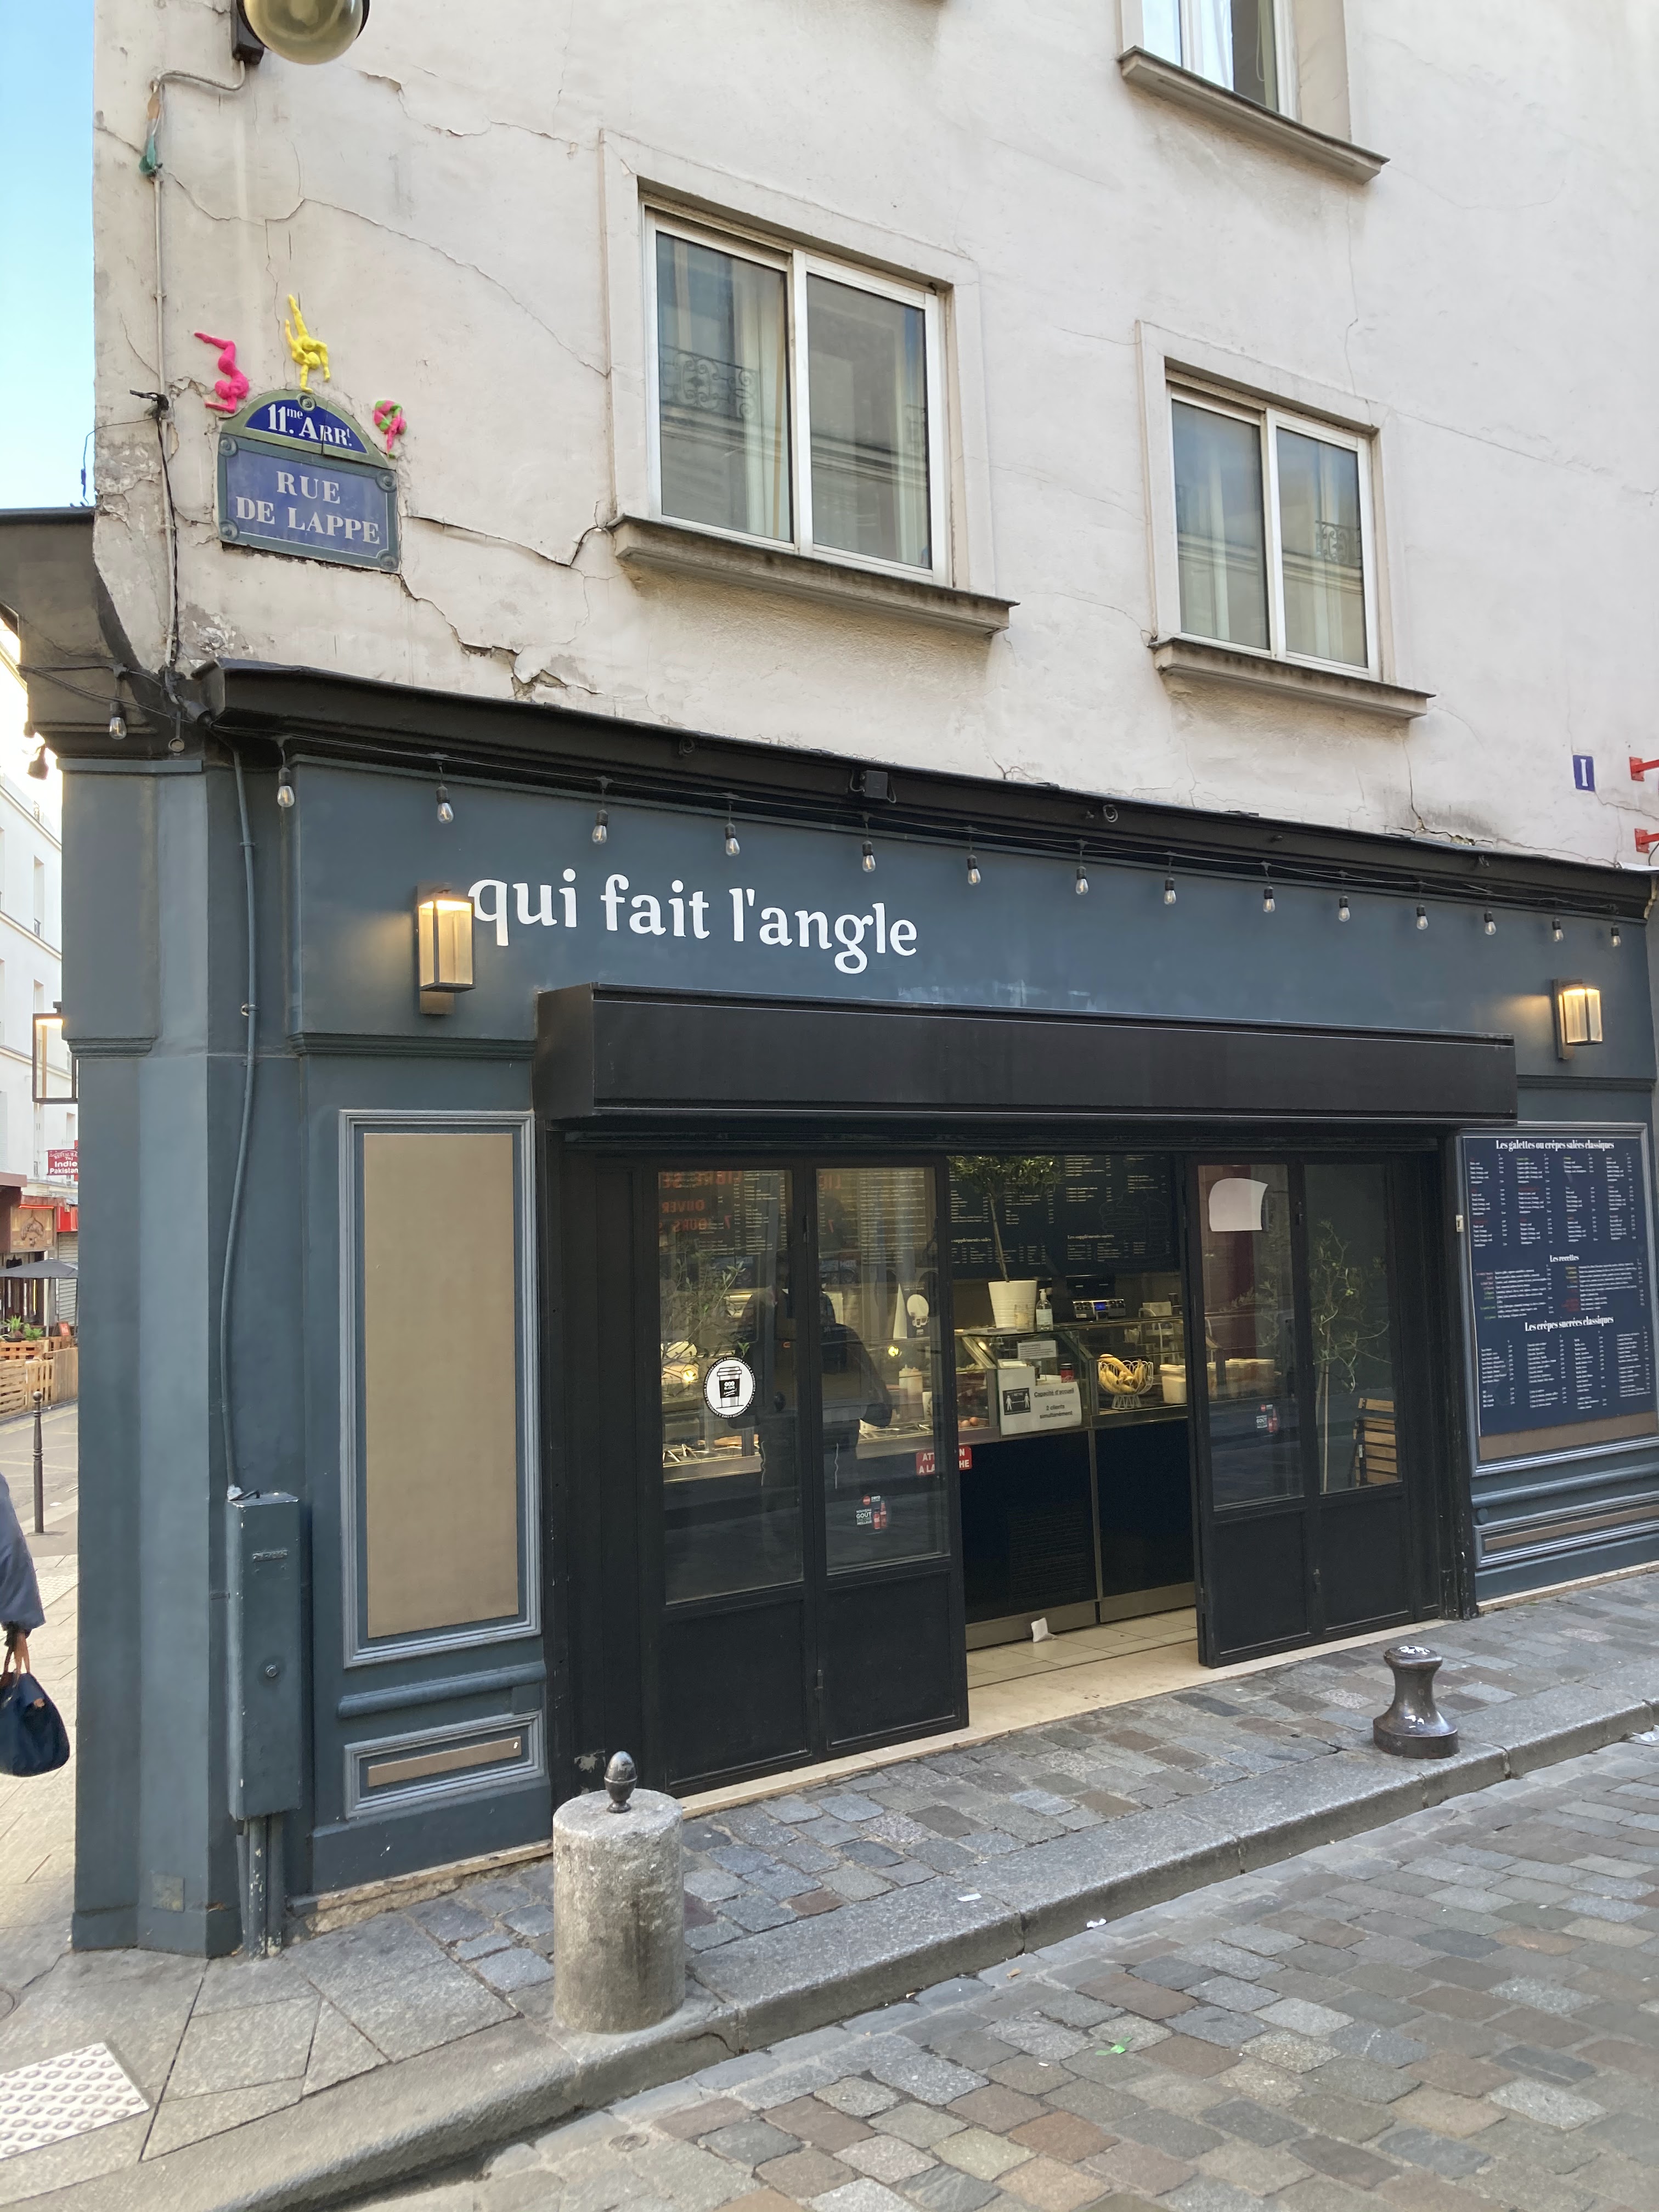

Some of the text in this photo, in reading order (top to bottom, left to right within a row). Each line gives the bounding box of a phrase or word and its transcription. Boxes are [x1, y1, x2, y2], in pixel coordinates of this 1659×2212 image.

[276, 471, 341, 504] RUE
[235, 496, 380, 544] DE LAPPE
[468, 868, 918, 974] qui fait l'angle
[1496, 1140, 1508, 1149] Les
[1508, 1139, 1535, 1152] galettes
[1544, 1139, 1566, 1152] crêpes
[1585, 1139, 1615, 1152] classiques
[1525, 1322, 1536, 1331] Les
[1537, 1320, 1558, 1332] crêpes
[1583, 1316, 1614, 1327] classiques
